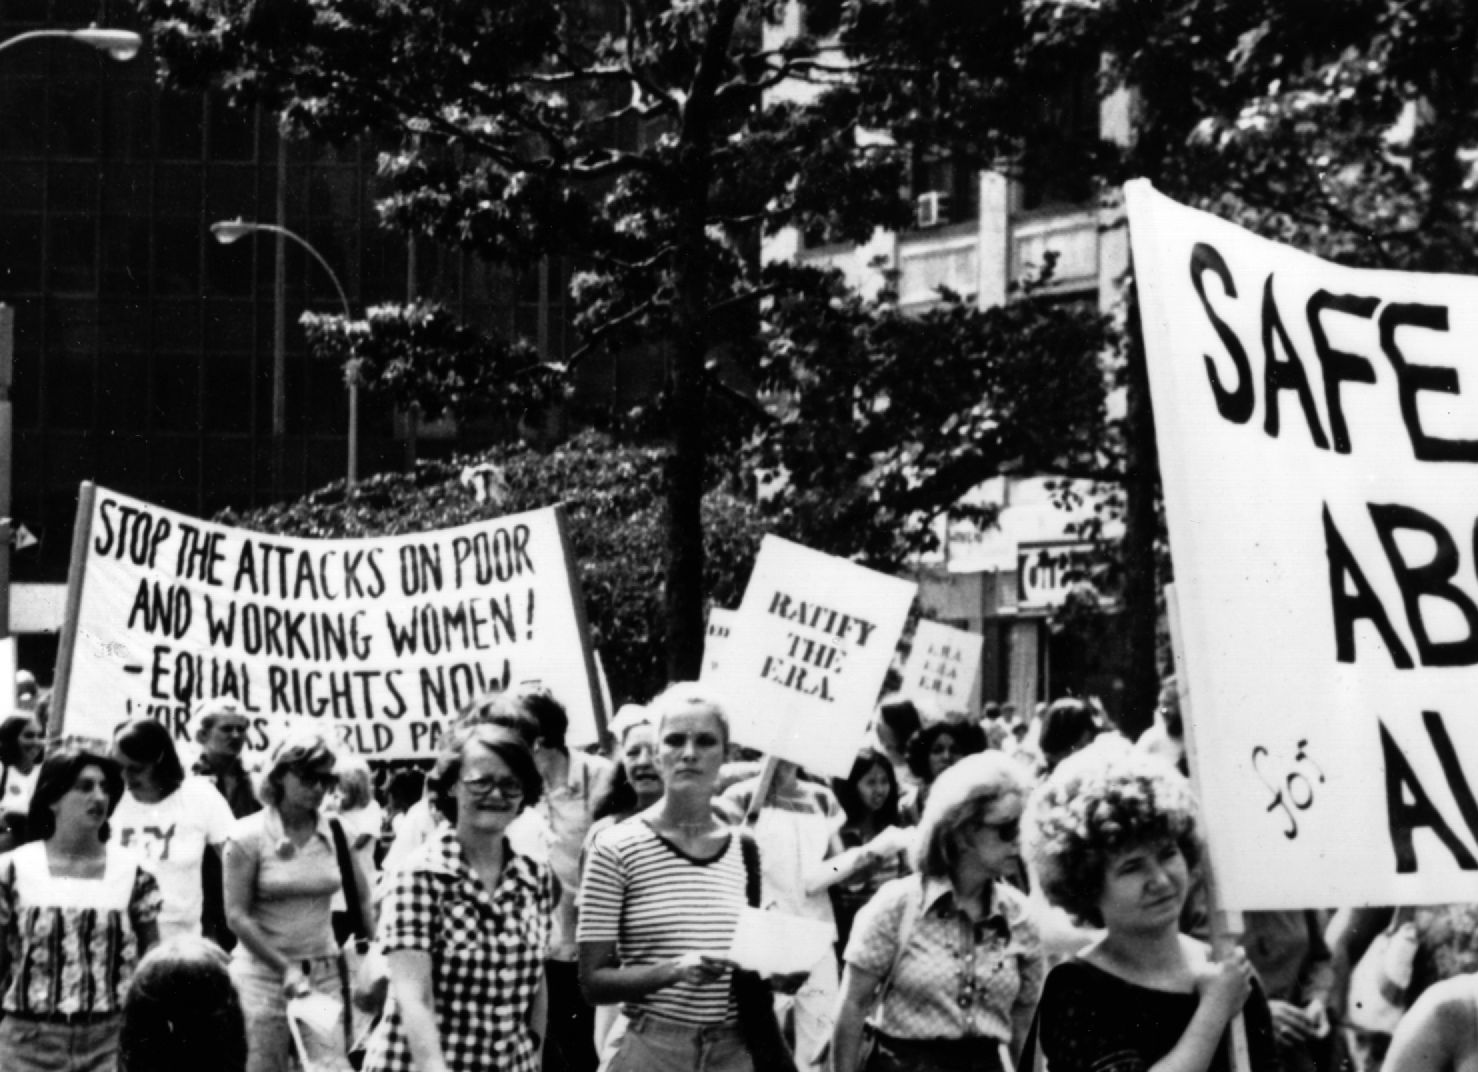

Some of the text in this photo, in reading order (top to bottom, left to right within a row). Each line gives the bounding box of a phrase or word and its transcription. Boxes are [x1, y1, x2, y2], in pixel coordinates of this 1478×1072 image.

[95, 498, 536, 600] STOP THE ATTACKS ON POOR
[128, 577, 192, 640] AND
[204, 593, 373, 661] WORKING
[768, 590, 878, 647] RATIFY
[787, 632, 847, 674] THE
[268, 664, 407, 720] RIGHTS
